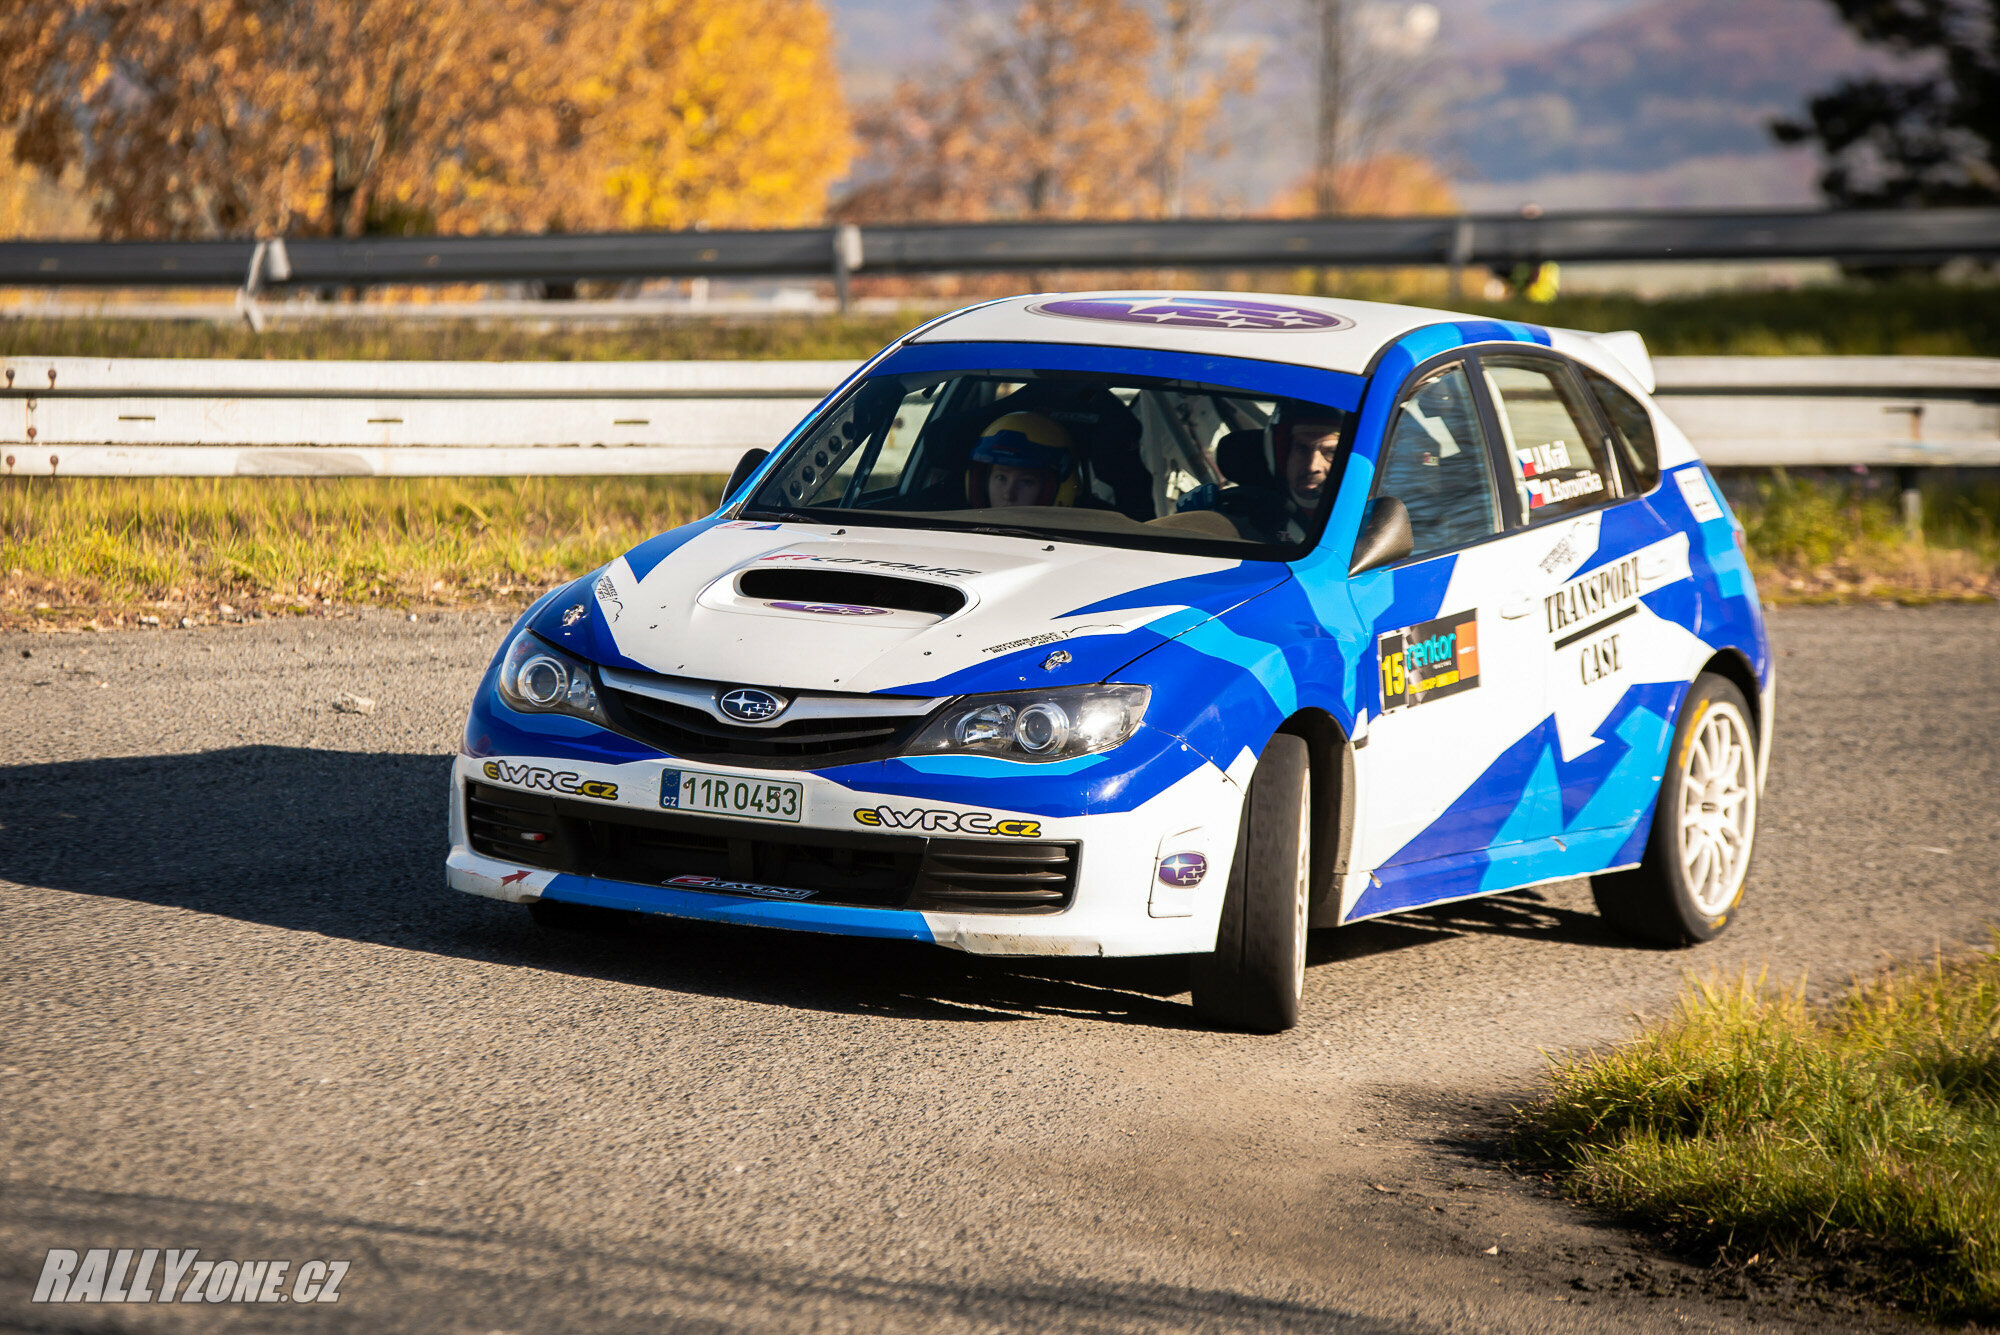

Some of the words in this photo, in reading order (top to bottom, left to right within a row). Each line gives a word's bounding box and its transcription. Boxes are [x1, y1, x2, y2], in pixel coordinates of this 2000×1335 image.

[1544, 556, 1640, 634] TRANSPORT
[1406, 632, 1457, 670] rentor
[1581, 633, 1622, 686] CASE
[1381, 651, 1405, 697] 15
[663, 795, 677, 807] CZ
[683, 777, 729, 809] 11R
[733, 782, 798, 816] 0453
